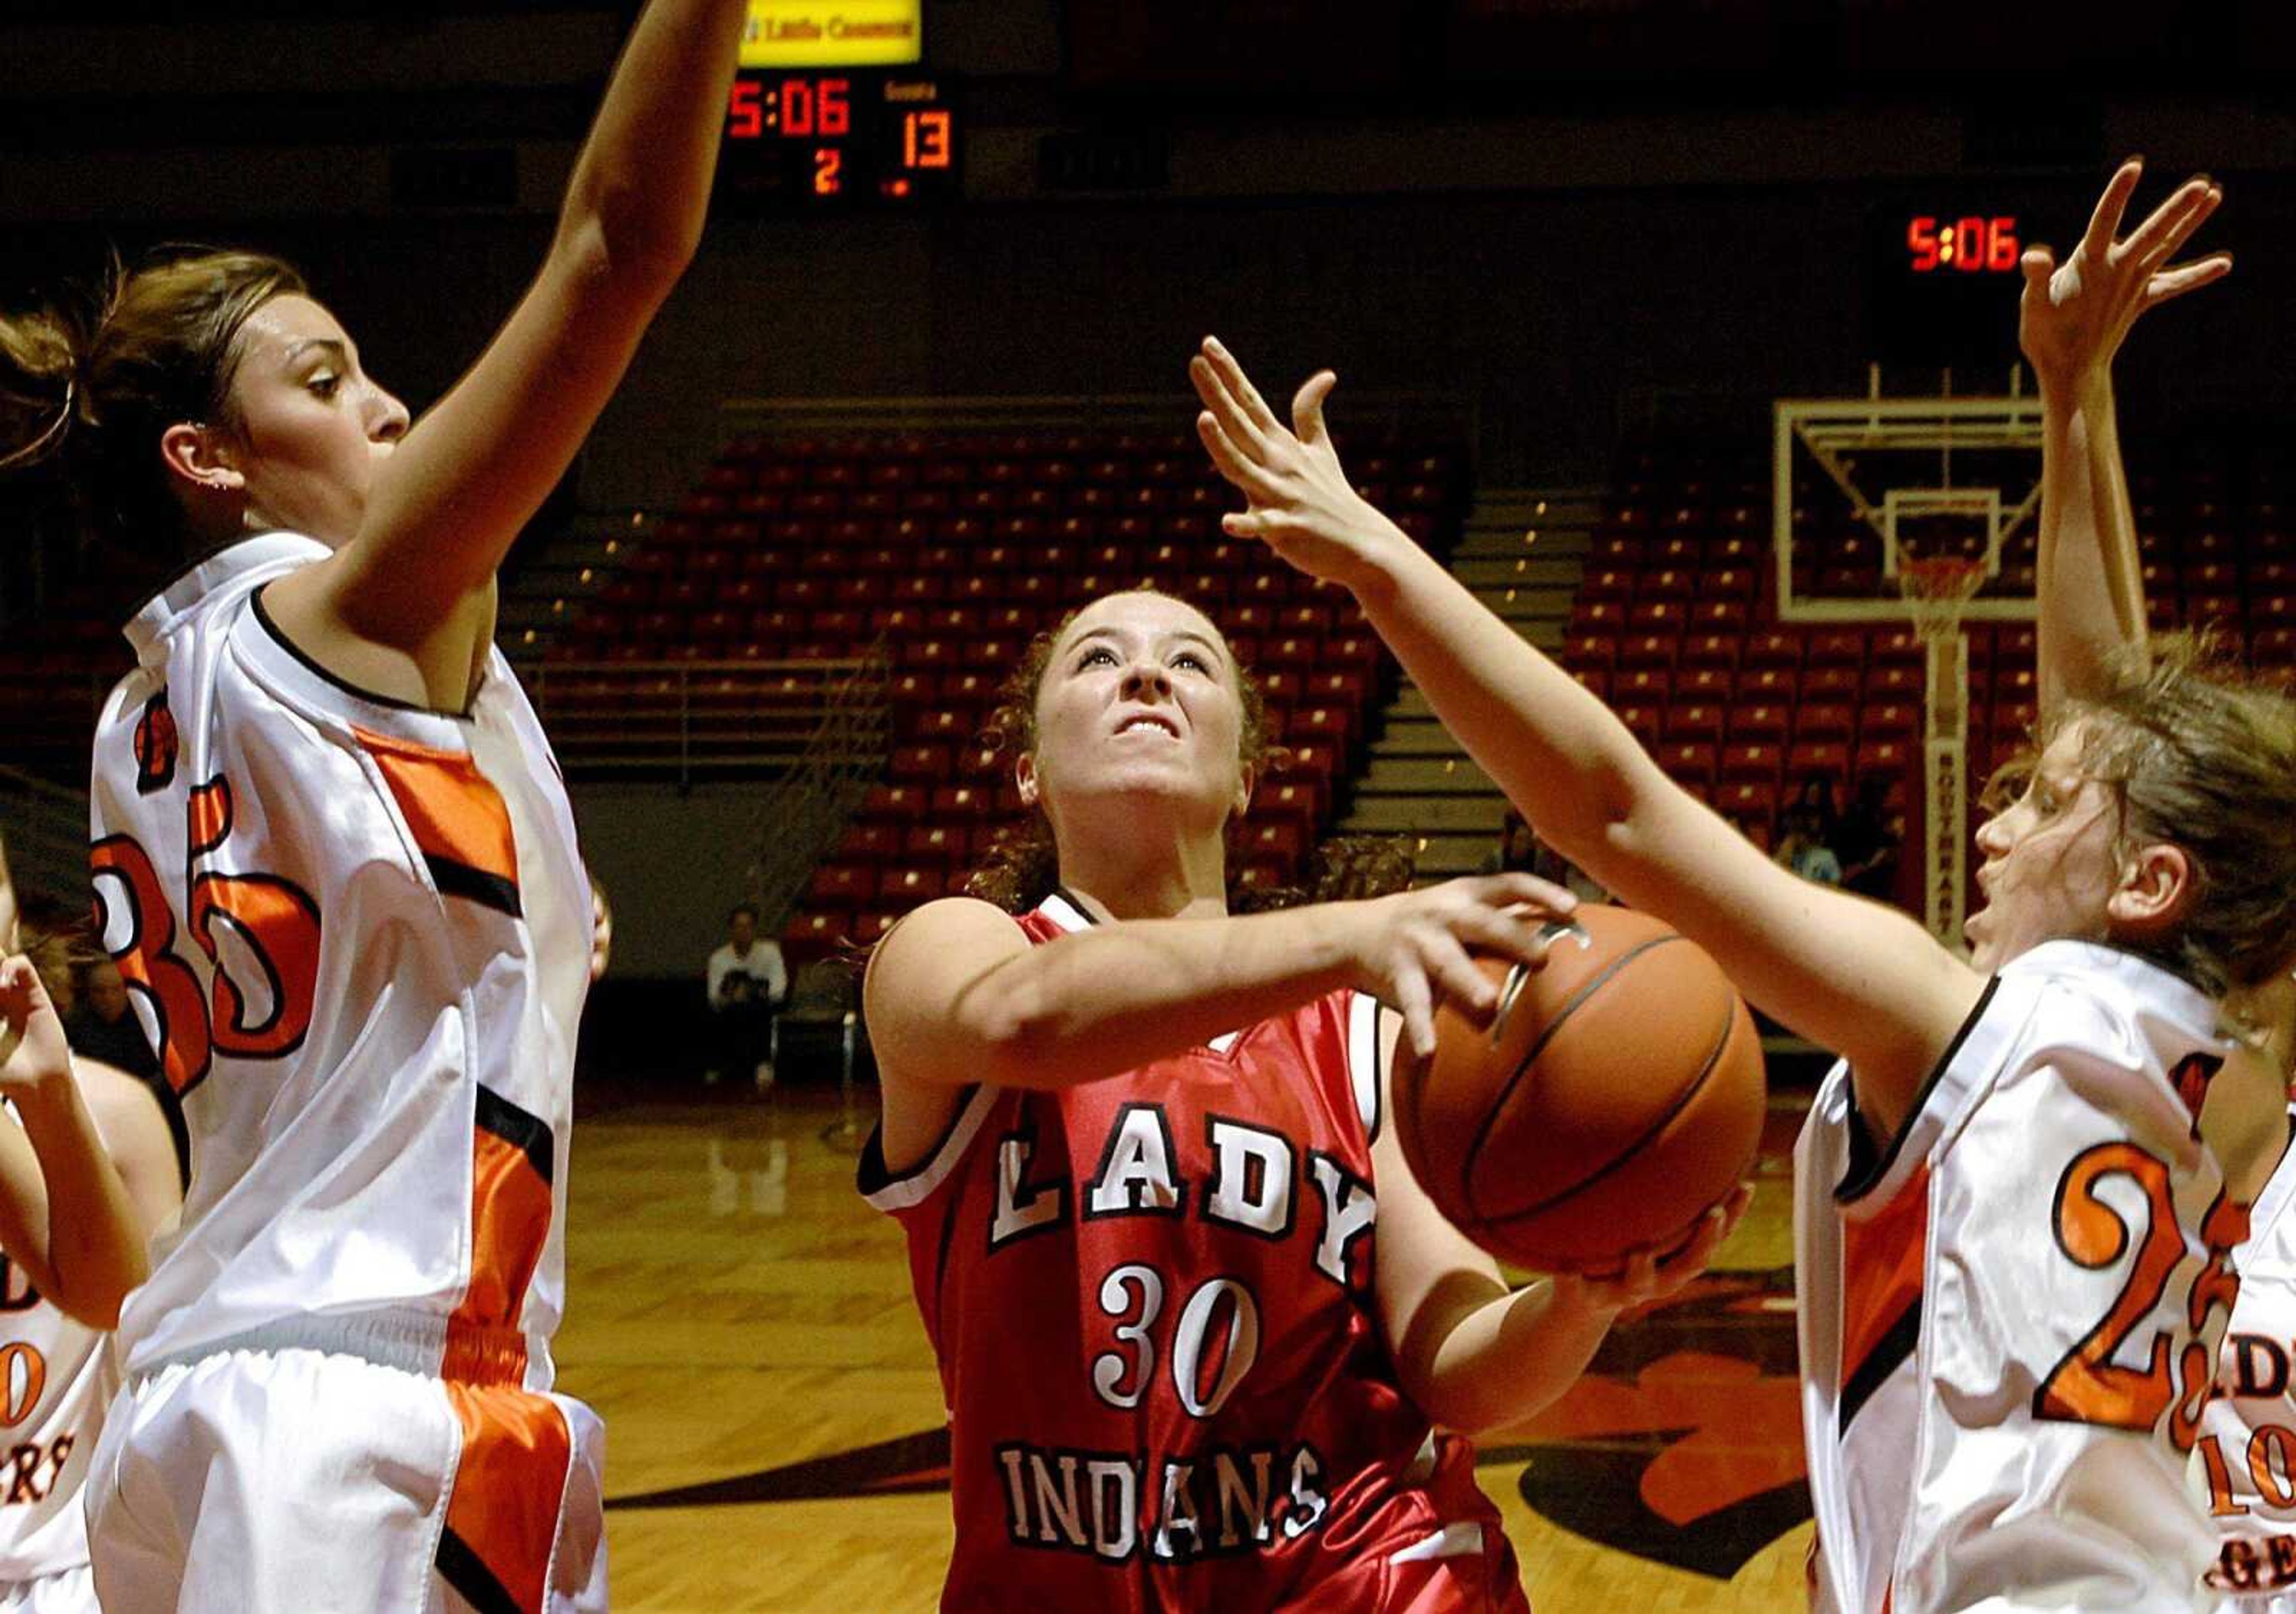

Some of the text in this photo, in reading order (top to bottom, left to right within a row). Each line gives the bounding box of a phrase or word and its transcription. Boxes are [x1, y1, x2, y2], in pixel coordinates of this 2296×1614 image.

[730, 80, 850, 137] 5:06
[903, 112, 951, 168] 13
[814, 148, 841, 195] 2
[1907, 216, 2020, 272] 5:06
[987, 1102, 1378, 1302] LADY
[1091, 1261, 1261, 1419] 30
[994, 1438, 1330, 1565] INDANS
